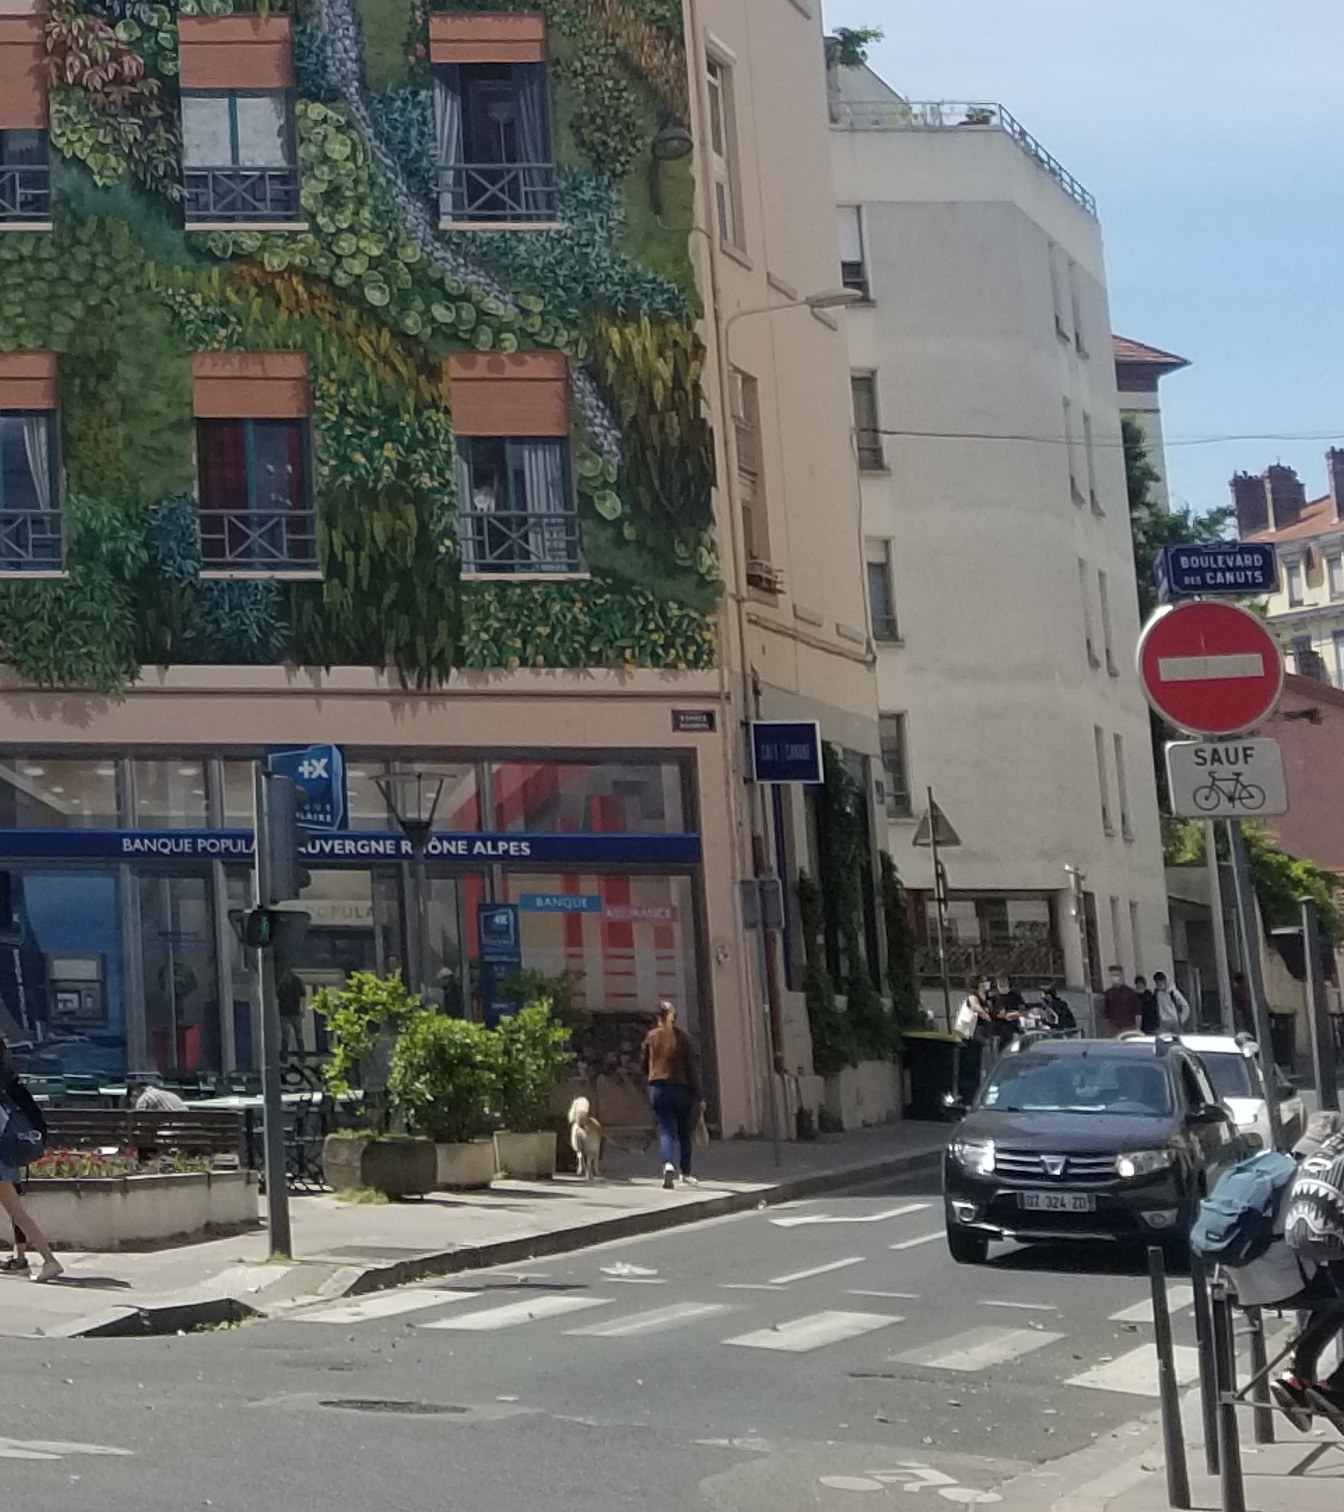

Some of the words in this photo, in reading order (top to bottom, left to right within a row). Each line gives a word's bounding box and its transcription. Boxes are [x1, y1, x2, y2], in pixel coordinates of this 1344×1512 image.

[1179, 553, 1264, 569] BOULEVARD
[1183, 576, 1202, 585] DES
[1205, 570, 1264, 585] CANUTS
[1193, 746, 1255, 767] SAUF
[122, 838, 193, 855] BANQUE
[197, 838, 257, 854] POPULA
[400, 836, 469, 855] RÔNE
[472, 840, 532, 856] ALPES
[536, 897, 588, 909] BANQUE
